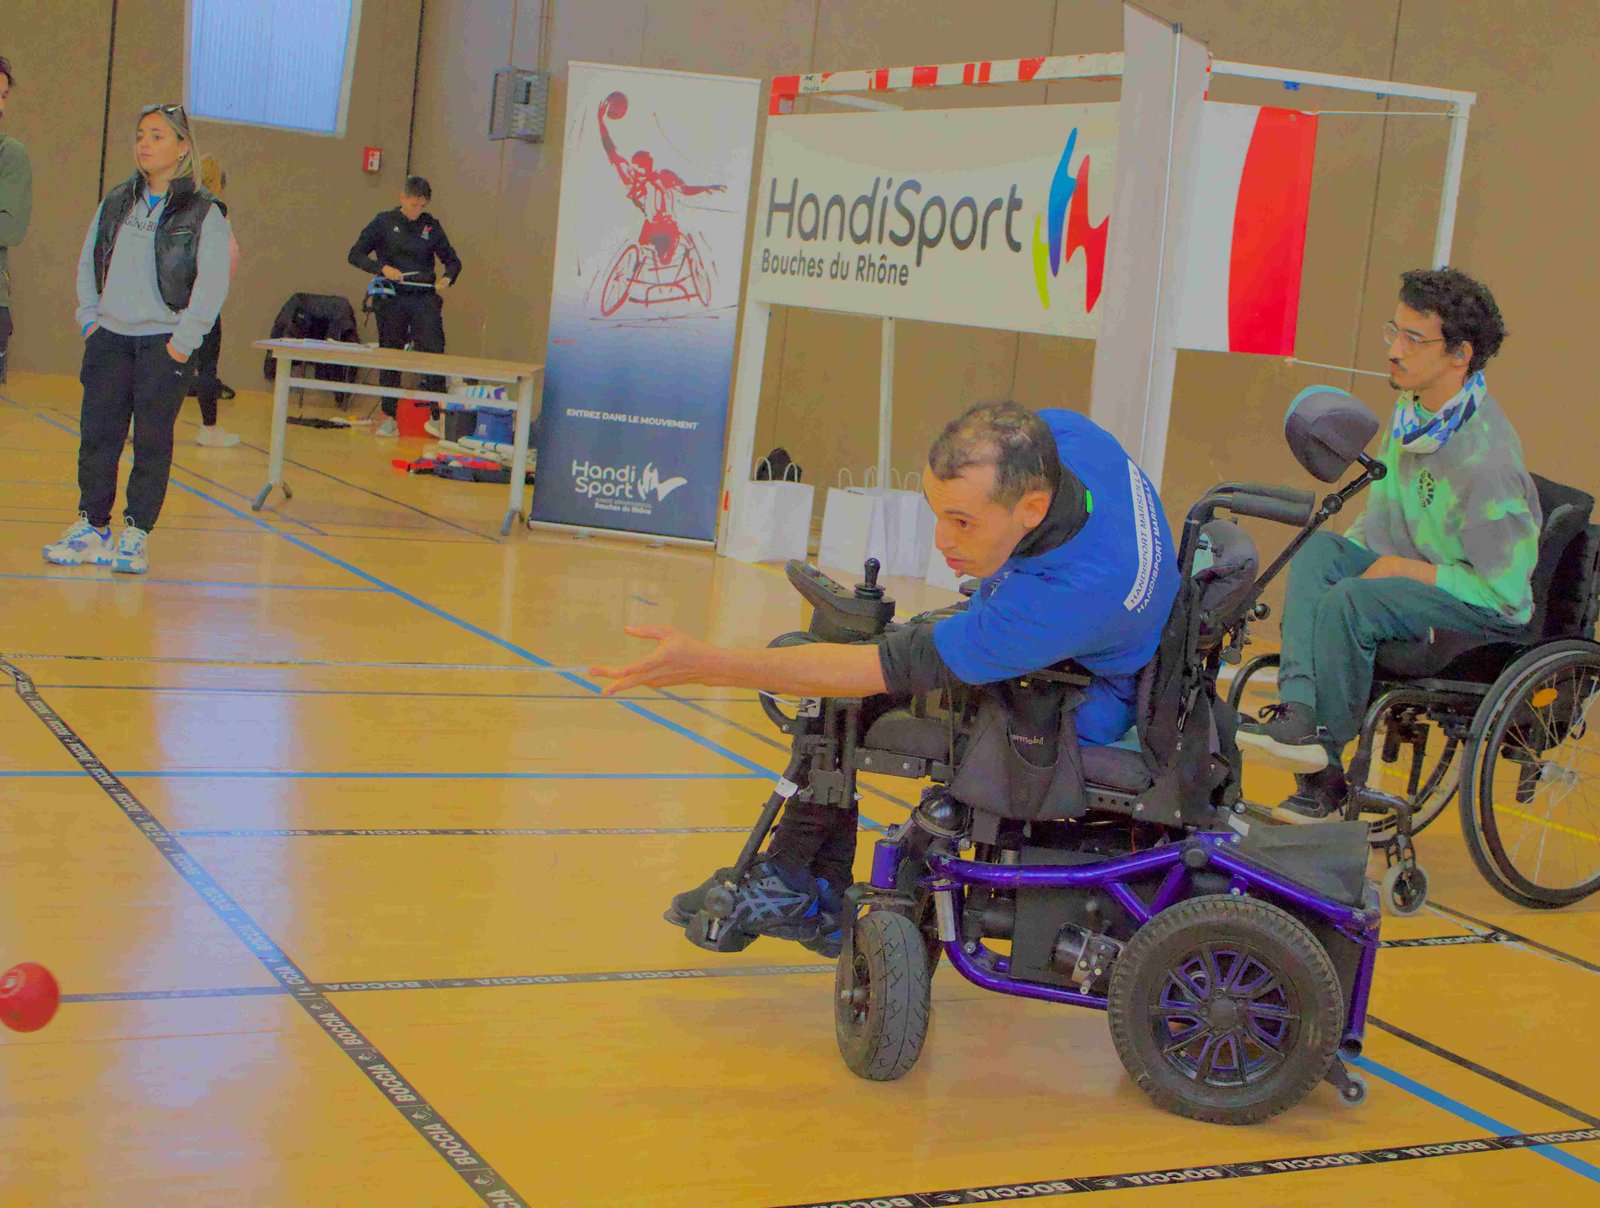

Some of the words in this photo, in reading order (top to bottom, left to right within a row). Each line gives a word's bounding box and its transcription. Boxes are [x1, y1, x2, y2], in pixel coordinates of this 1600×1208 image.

[765, 176, 1023, 267] HandiSport
[761, 248, 824, 278] Bouches
[829, 252, 849, 280] du
[855, 254, 909, 286] Rhône
[566, 408, 601, 419] ENTREZ
[602, 412, 627, 423] DANS
[628, 415, 639, 424] LE
[640, 416, 699, 430] MOUVEMENT
[572, 459, 636, 482] Handi
[574, 477, 634, 498] Sport
[1132, 469, 1148, 528] MARSEILLE
[1130, 531, 1149, 604] HANDISPORT
[1136, 540, 1162, 614] HANDISPORT
[1011, 734, 1044, 745] ermobil
[323, 981, 423, 991] BOCCIA
[474, 975, 569, 986] BOCCIA
[617, 970, 706, 980] BOCCIA
[318, 1012, 364, 1046] BOCCIA
[367, 1063, 417, 1102] BOCCIA
[422, 1123, 479, 1166] BOCCIA
[1400, 1140, 1490, 1157] BOCCIA
[1267, 1153, 1363, 1172] BOCCIA
[1122, 1168, 1224, 1185] BOCCIA
[965, 1181, 1074, 1201] BOCCIA
